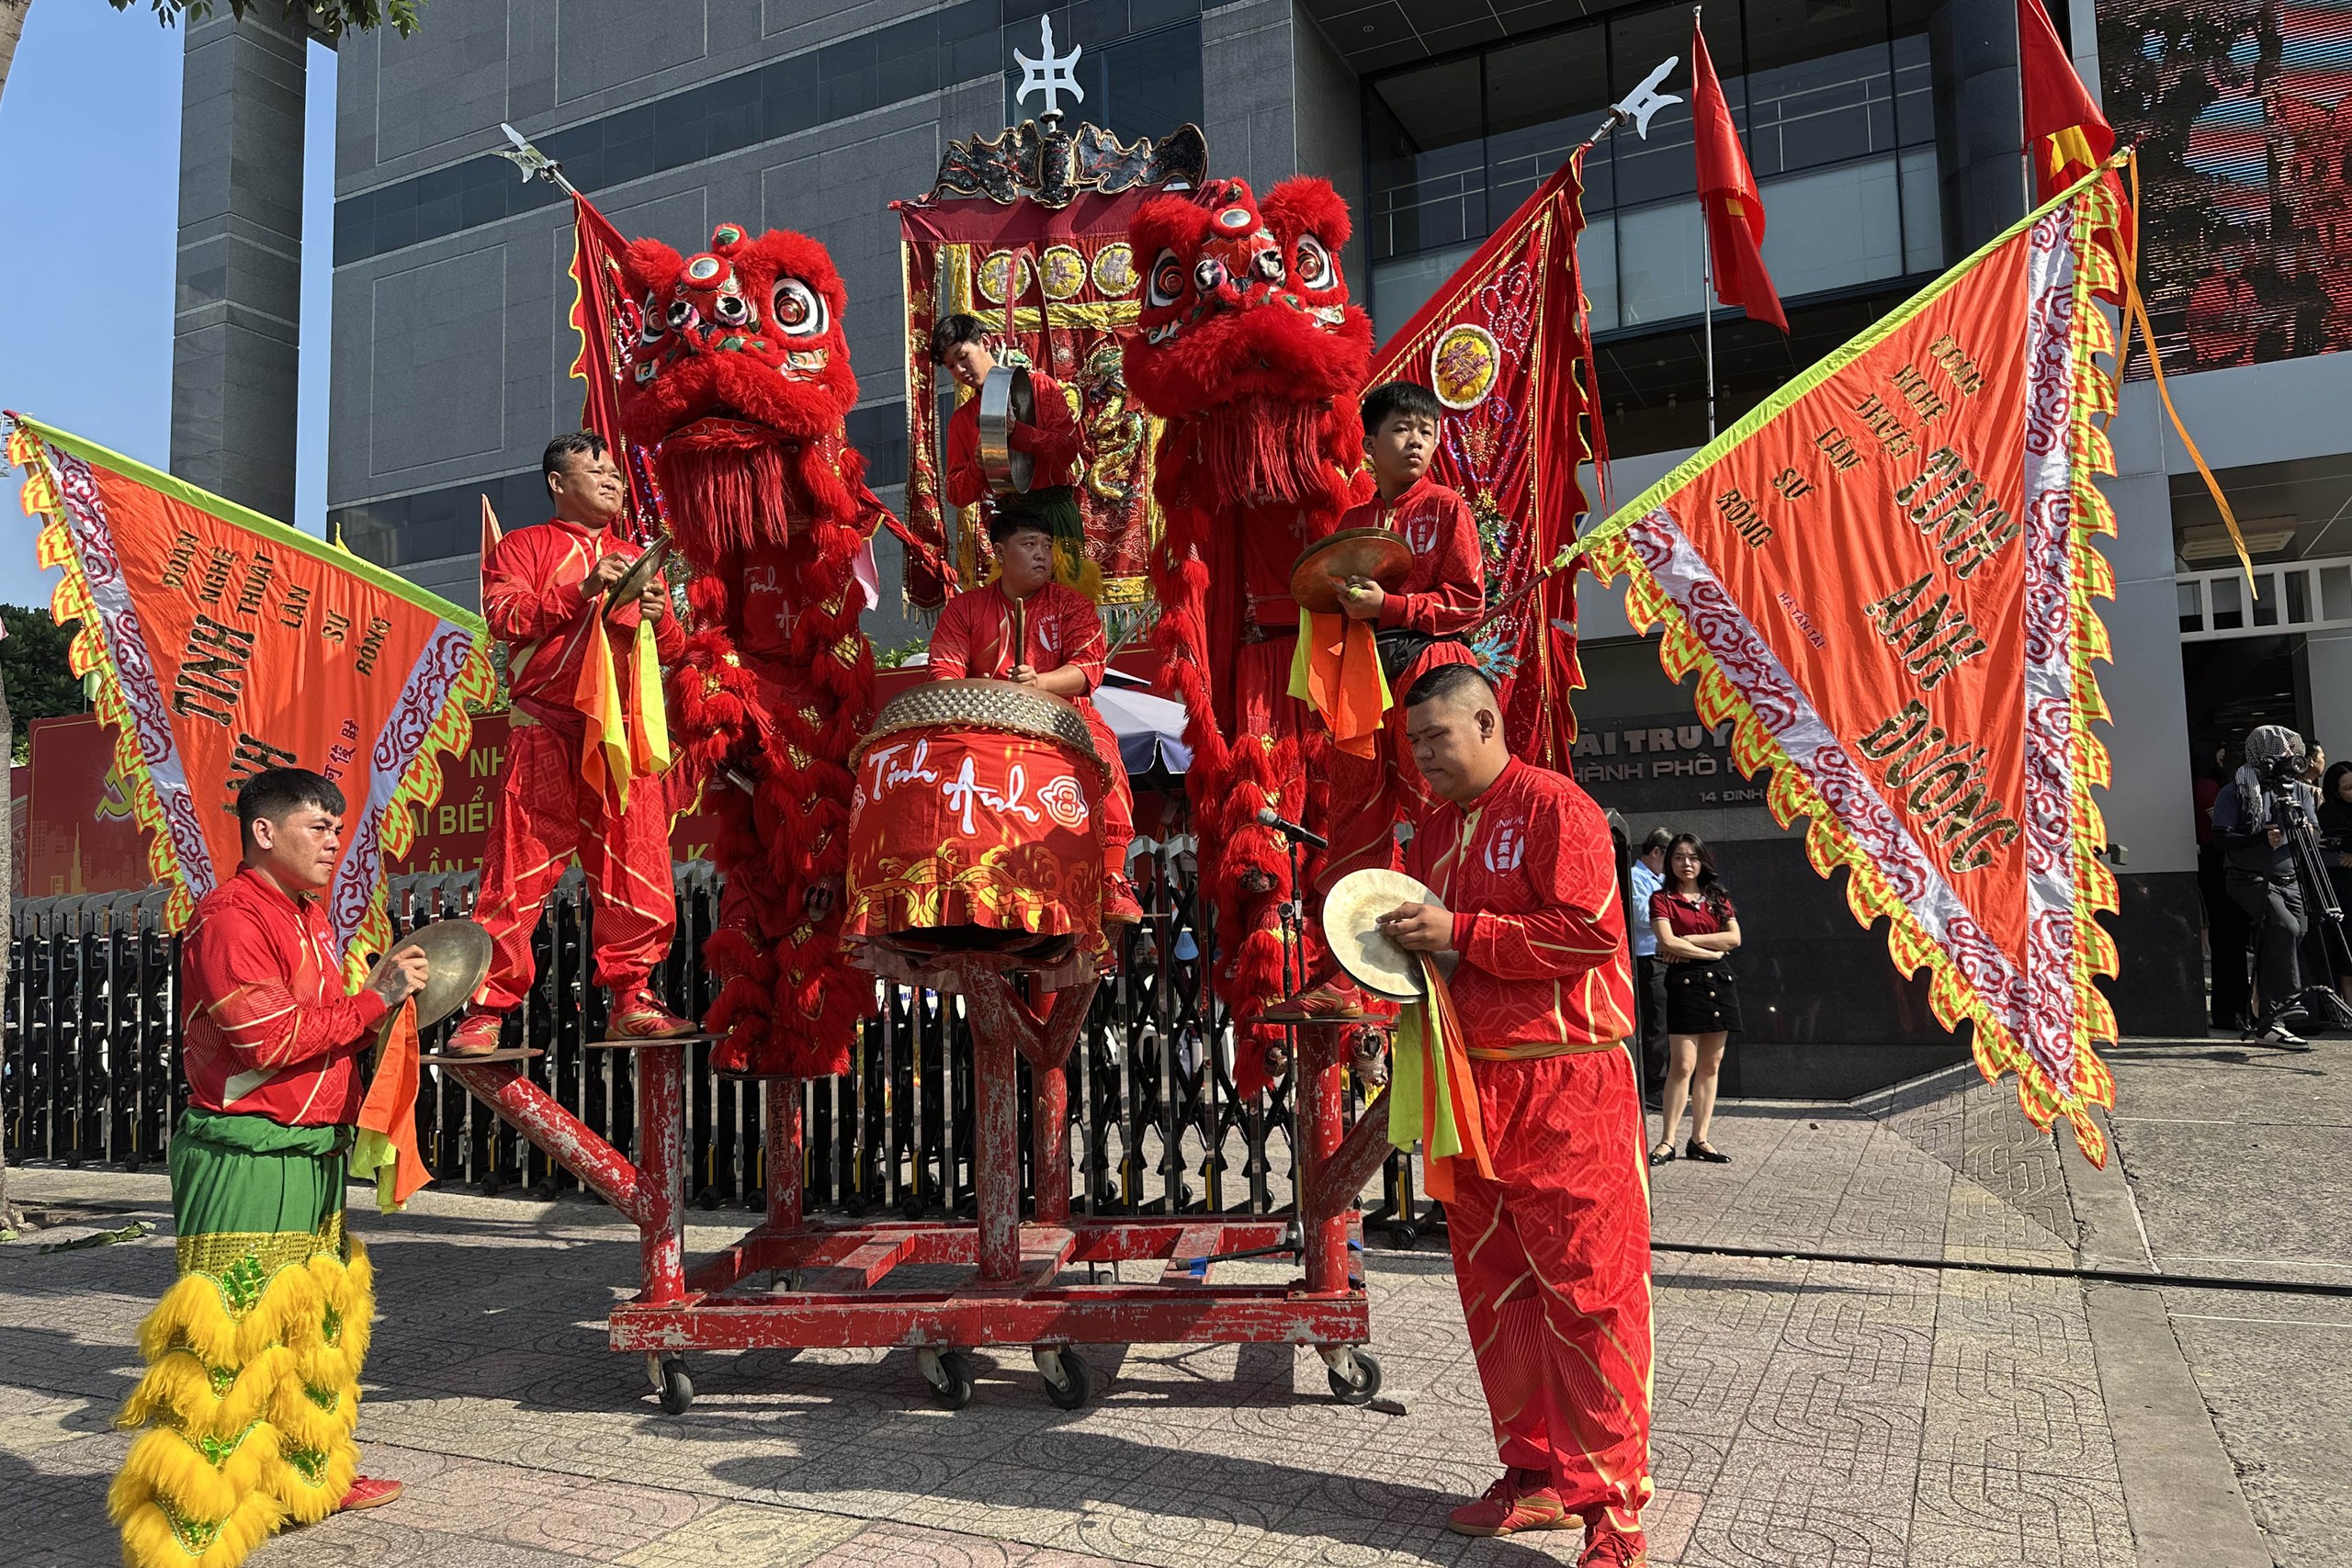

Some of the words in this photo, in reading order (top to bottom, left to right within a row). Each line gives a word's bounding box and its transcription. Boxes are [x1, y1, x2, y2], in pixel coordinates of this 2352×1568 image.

[1891, 364, 1951, 428] NGHỆ
[1928, 333, 1985, 398] ĐOÀN
[1814, 427, 1865, 475] LÂN
[1855, 393, 1920, 461] THUẬT
[1772, 467, 1815, 502] SƯ
[1894, 445, 2021, 581] TINH
[1715, 488, 1775, 551] RỒNG
[162, 529, 200, 590] ĐOÀN
[198, 547, 240, 605] NGHỆ
[236, 551, 275, 615] THUẬT
[278, 583, 311, 629] LÂN
[1863, 571, 1988, 692] ANH
[169, 613, 256, 728] TINH
[353, 615, 393, 677] RỒNG
[1572, 727, 1618, 758] ÀI
[1574, 761, 1644, 784] HÀNH
[943, 756, 1040, 834] Anh
[1699, 790, 1717, 803] 14
[1722, 788, 1764, 802] ĐINH
